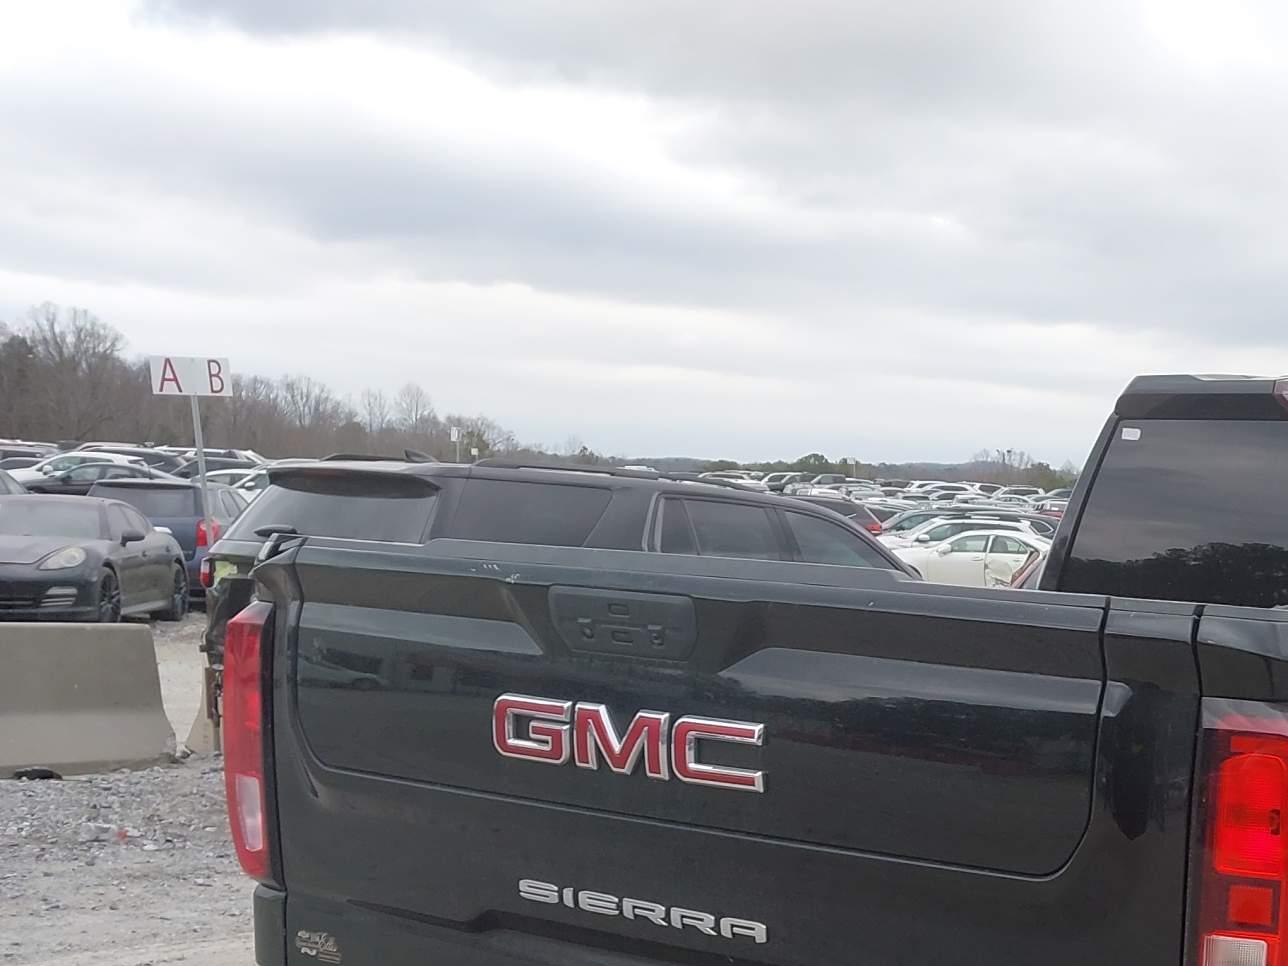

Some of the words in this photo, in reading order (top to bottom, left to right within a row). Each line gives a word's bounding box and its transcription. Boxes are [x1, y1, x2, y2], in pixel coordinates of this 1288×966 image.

[159, 357, 183, 393] A
[207, 359, 225, 394] B
[492, 692, 764, 793] GMC
[518, 878, 767, 944] SIERRA
